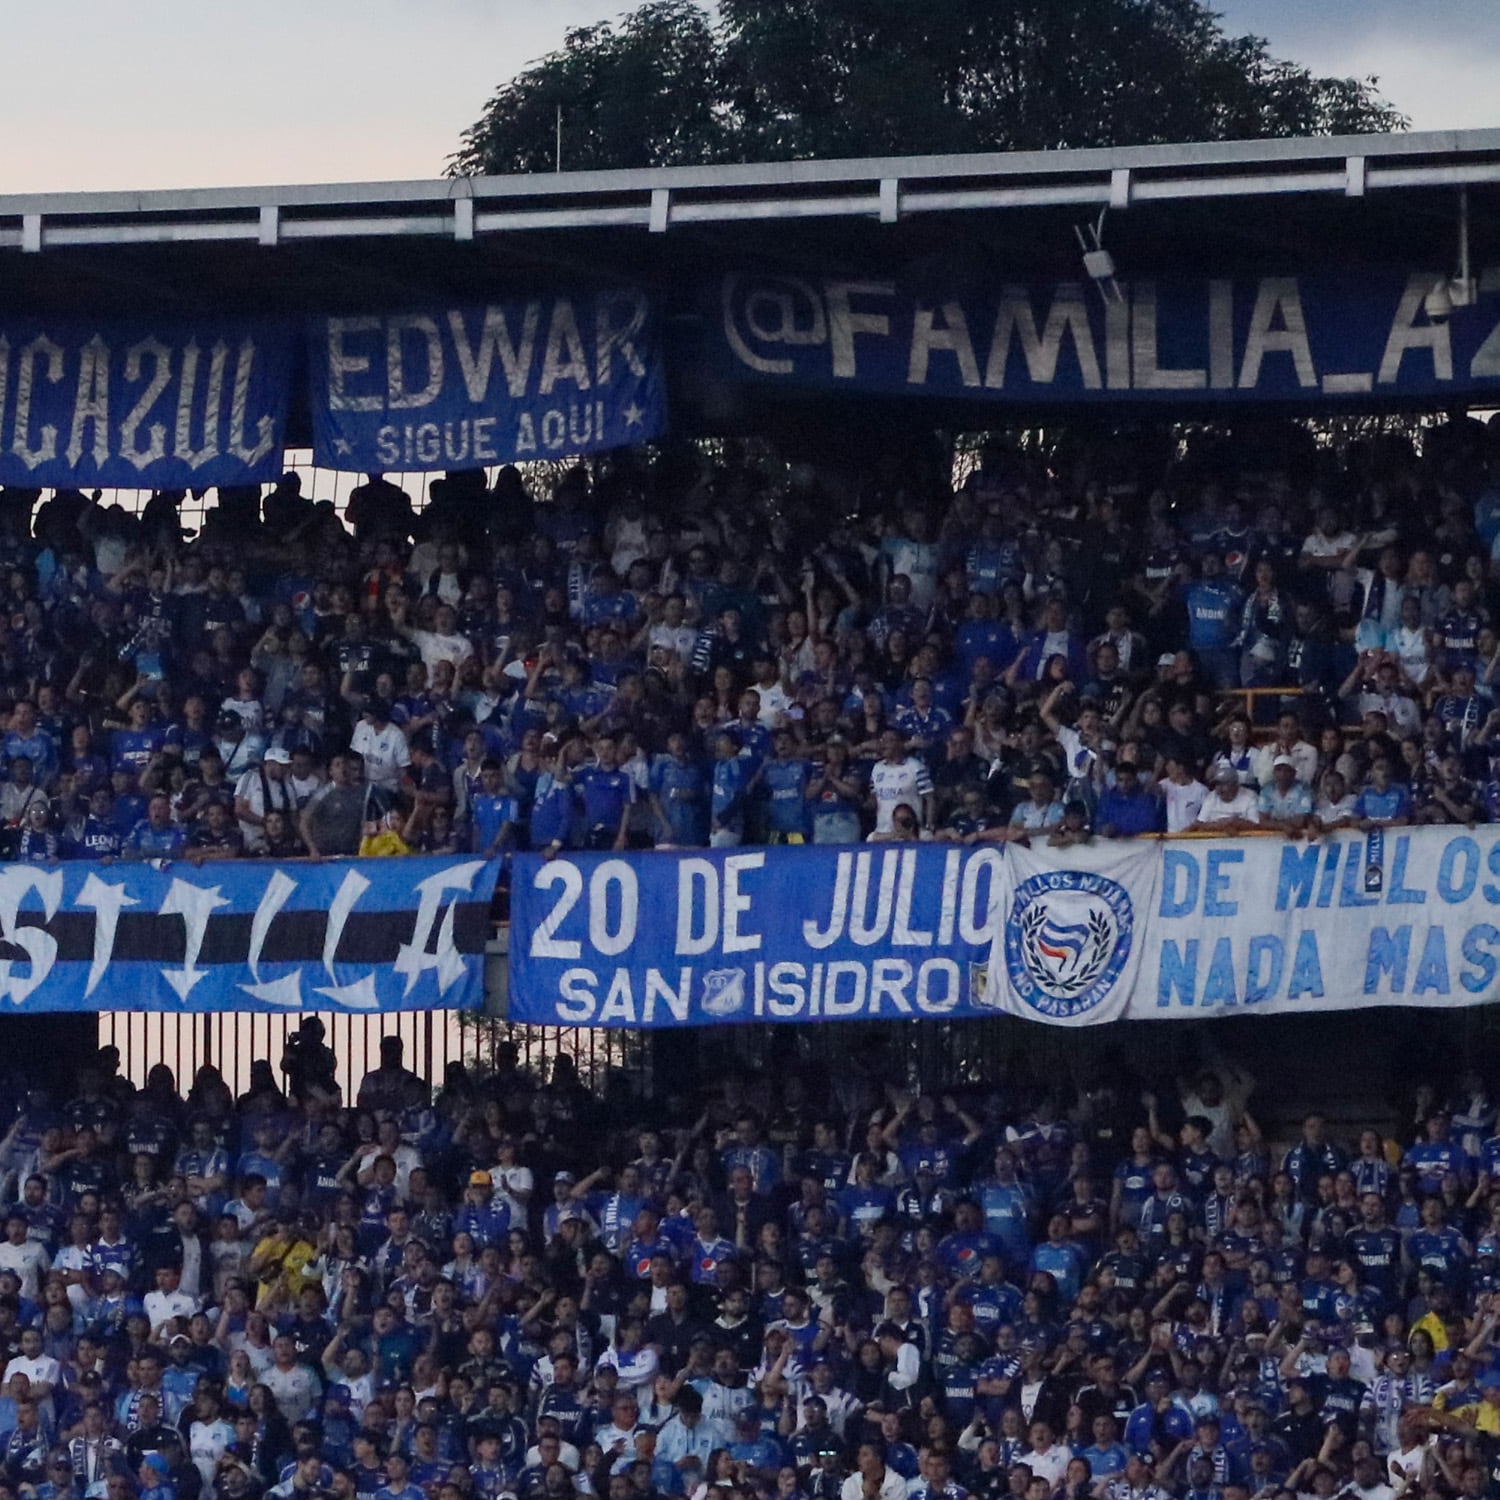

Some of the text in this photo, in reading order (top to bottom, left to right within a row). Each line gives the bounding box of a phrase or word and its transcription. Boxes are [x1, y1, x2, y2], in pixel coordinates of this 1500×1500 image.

[376, 400, 607, 465] SIGUE AQUI
[531, 845, 999, 959] 20 DE JULIO
[1158, 849, 1245, 918] DE
[556, 956, 959, 1023] SAN ISIDRO
[1157, 923, 1500, 1008] NADA MAS
